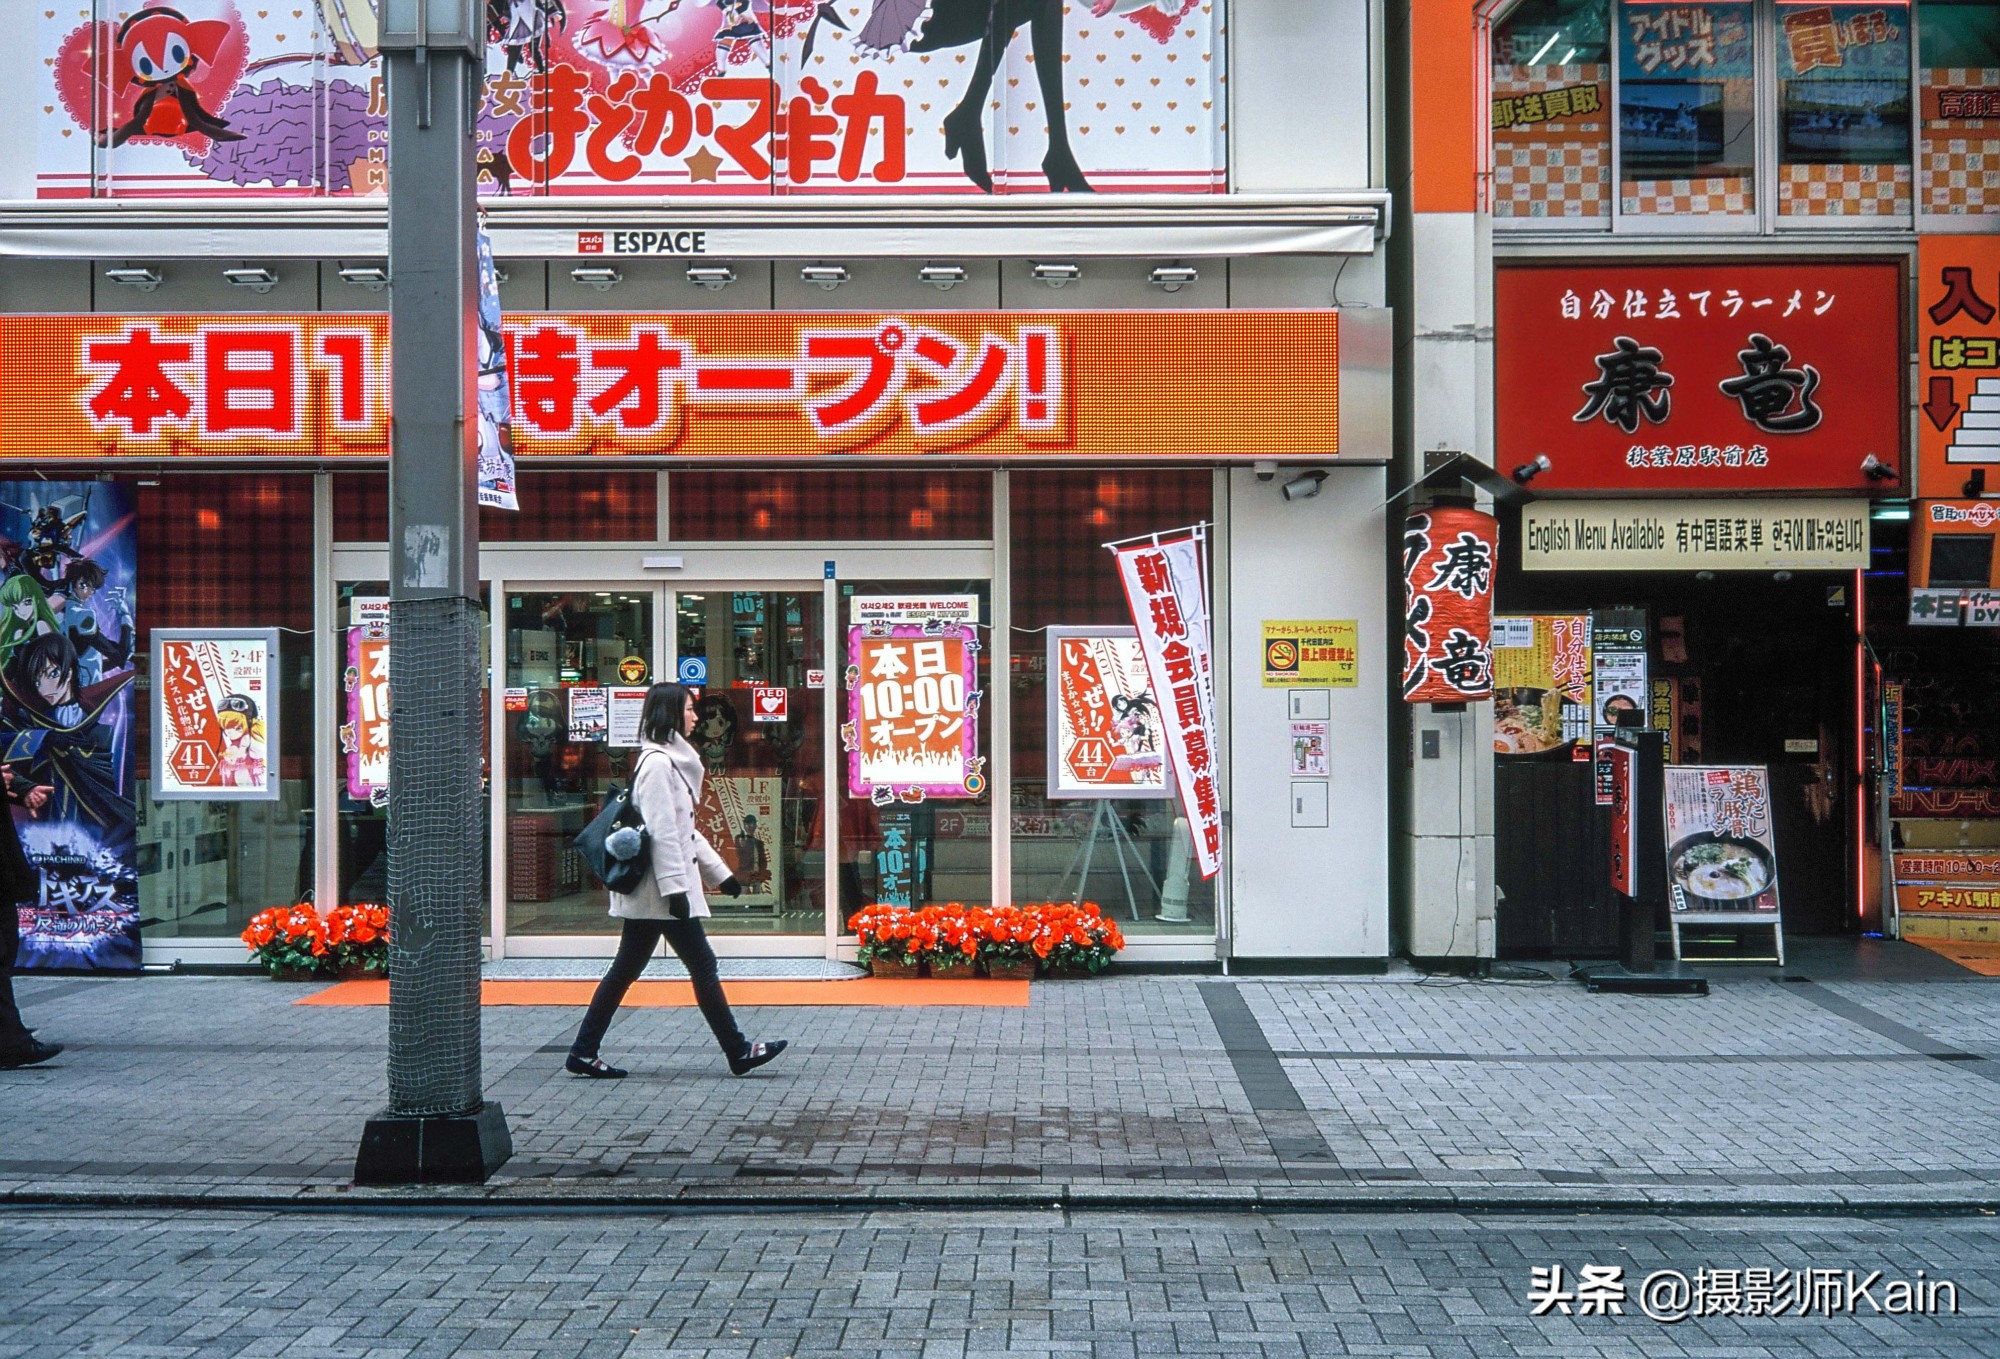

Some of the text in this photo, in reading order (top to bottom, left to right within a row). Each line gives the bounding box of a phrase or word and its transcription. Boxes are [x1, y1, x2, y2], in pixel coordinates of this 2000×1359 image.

[1629, 8, 1713, 43] アイドル
[1635, 37, 1717, 74] グッズ
[1492, 84, 1600, 129] 郵送買取
[613, 231, 706, 253] ESPACE
[1560, 289, 1836, 321] 自分仕立てラーメン
[1626, 444, 1769, 468] 秋葉原駅前店
[1528, 518, 1665, 554] English Menu Available
[1676, 518, 1764, 552] 有中国語菜単
[1912, 594, 1960, 619] 本日
[195, 643, 215, 680] SLOT
[870, 641, 948, 679] 本日
[1093, 641, 1112, 677] SLOT
[1301, 648, 1354, 661] 路上喫煙禁止
[1552, 620, 1567, 680] ラーメン
[1567, 617, 1588, 703] 自分仕立て
[757, 689, 784, 697] AED
[860, 674, 963, 720] 10:00
[1134, 551, 1220, 865] 新規会員募集中
[870, 714, 964, 746] オープン
[180, 744, 206, 766] 41
[1077, 742, 1103, 763] 44
[188, 769, 200, 779] 台
[1086, 766, 1097, 777] 台
[715, 778, 738, 830] PACHINKO
[1708, 787, 1726, 837] ラーメン
[1723, 800, 1746, 838] 豚骨
[1731, 770, 1767, 837] 鶏だし
[43, 855, 86, 864] PACHINKO
[23, 914, 123, 938] 反逆のルルーシュ
